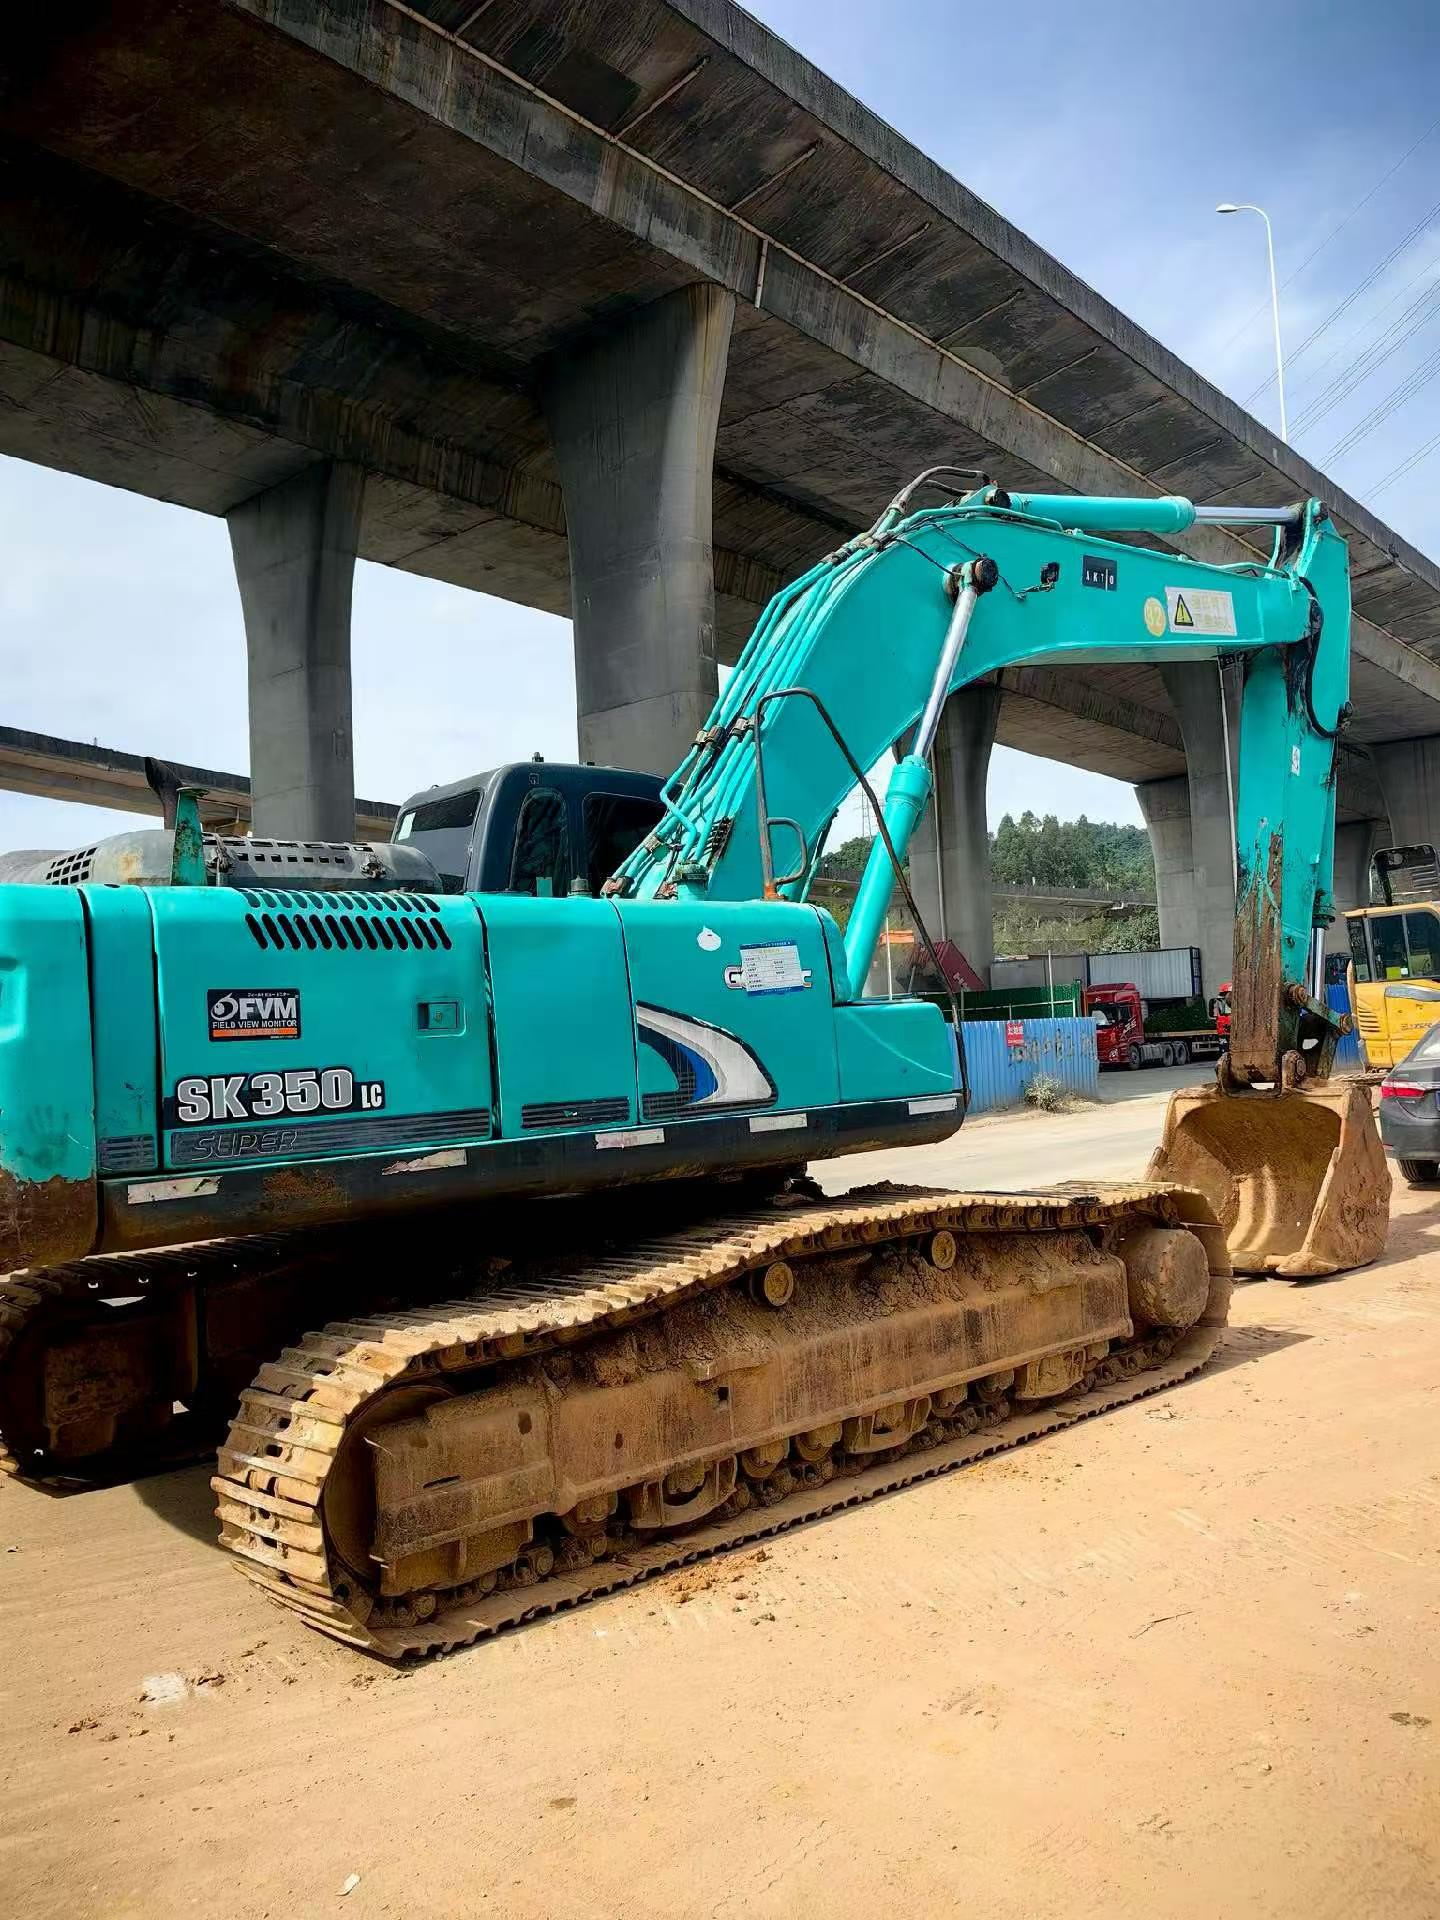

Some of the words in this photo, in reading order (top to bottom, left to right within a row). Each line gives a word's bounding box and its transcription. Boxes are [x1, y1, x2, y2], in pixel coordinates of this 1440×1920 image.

[239, 998, 297, 1019] FVM
[212, 1021, 236, 1029] FIELD
[238, 1021, 260, 1029] VIEW
[261, 1019, 298, 1028] MONITOR
[361, 1084, 382, 1109] LC
[191, 1130, 298, 1161] SUPER
